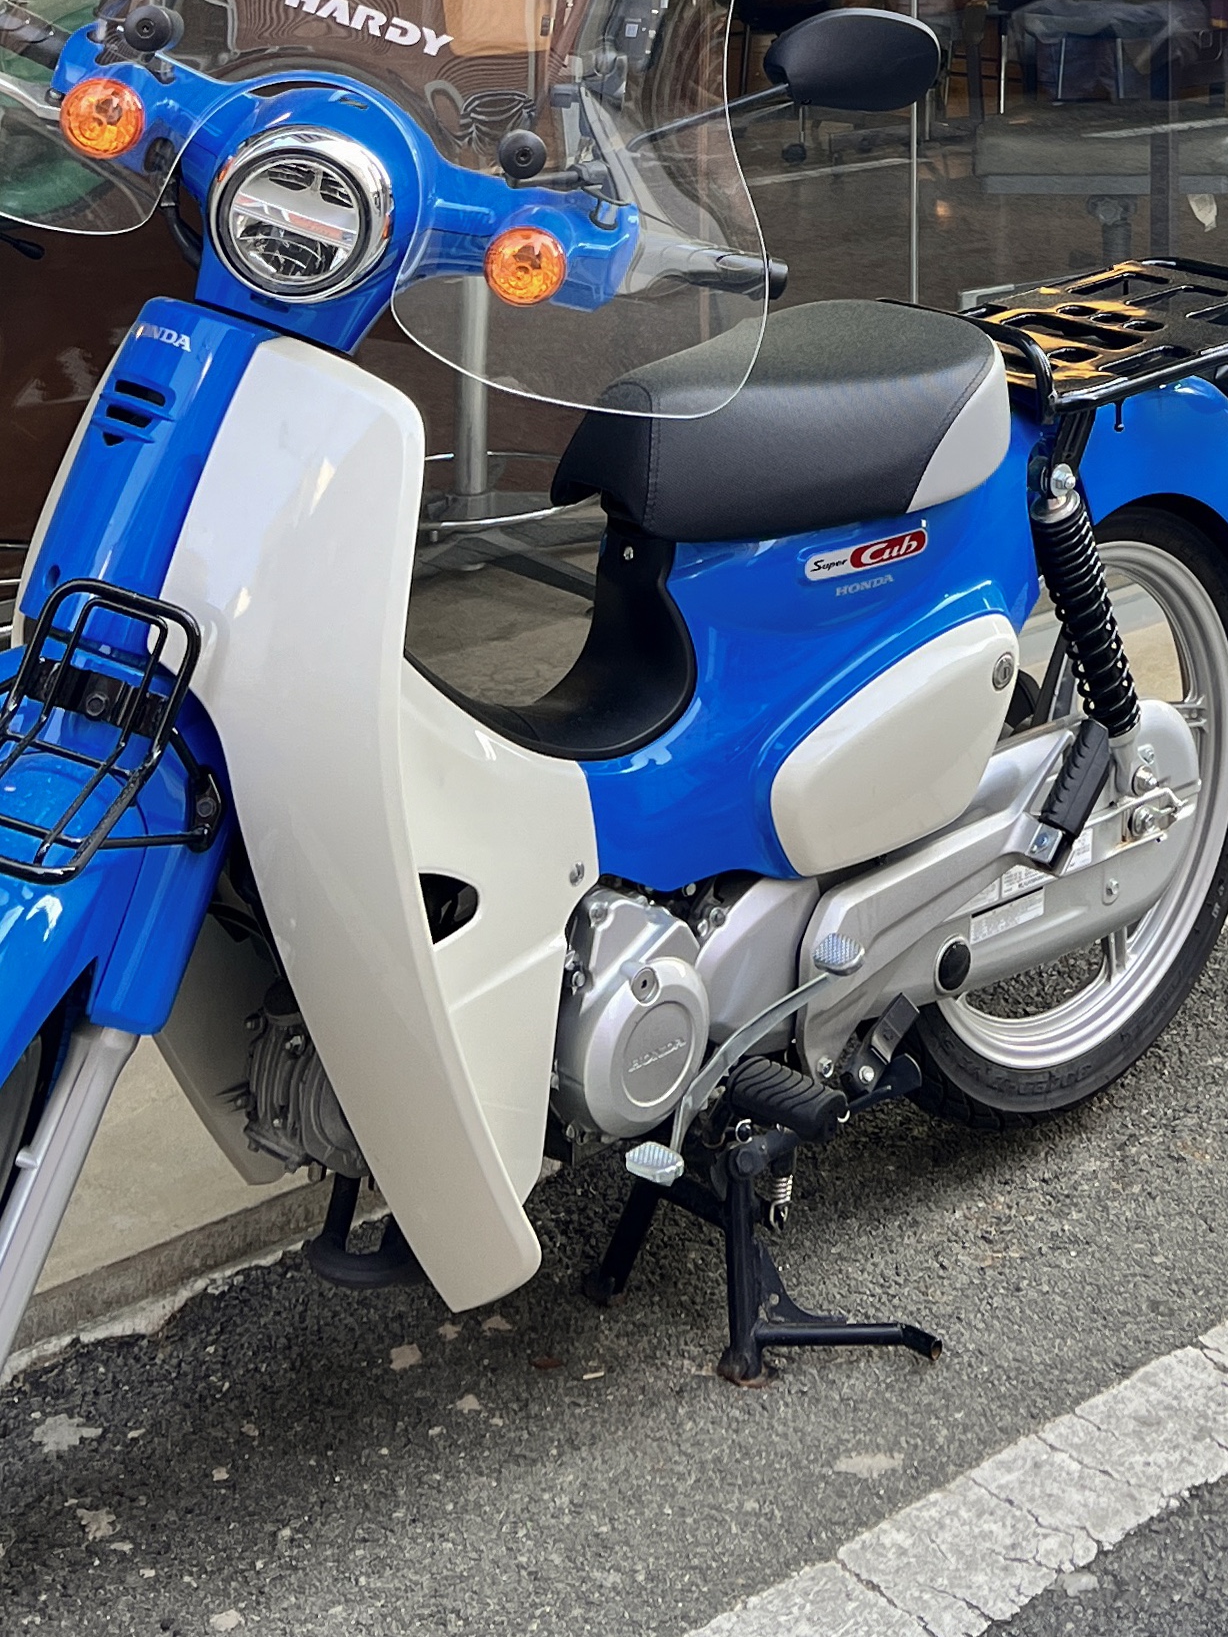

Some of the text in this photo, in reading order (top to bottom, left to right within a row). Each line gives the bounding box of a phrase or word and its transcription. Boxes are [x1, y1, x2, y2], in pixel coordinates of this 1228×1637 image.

[136, 322, 192, 353] NDA
[810, 534, 918, 573] Super Cub
[835, 573, 895, 597] HONDA
